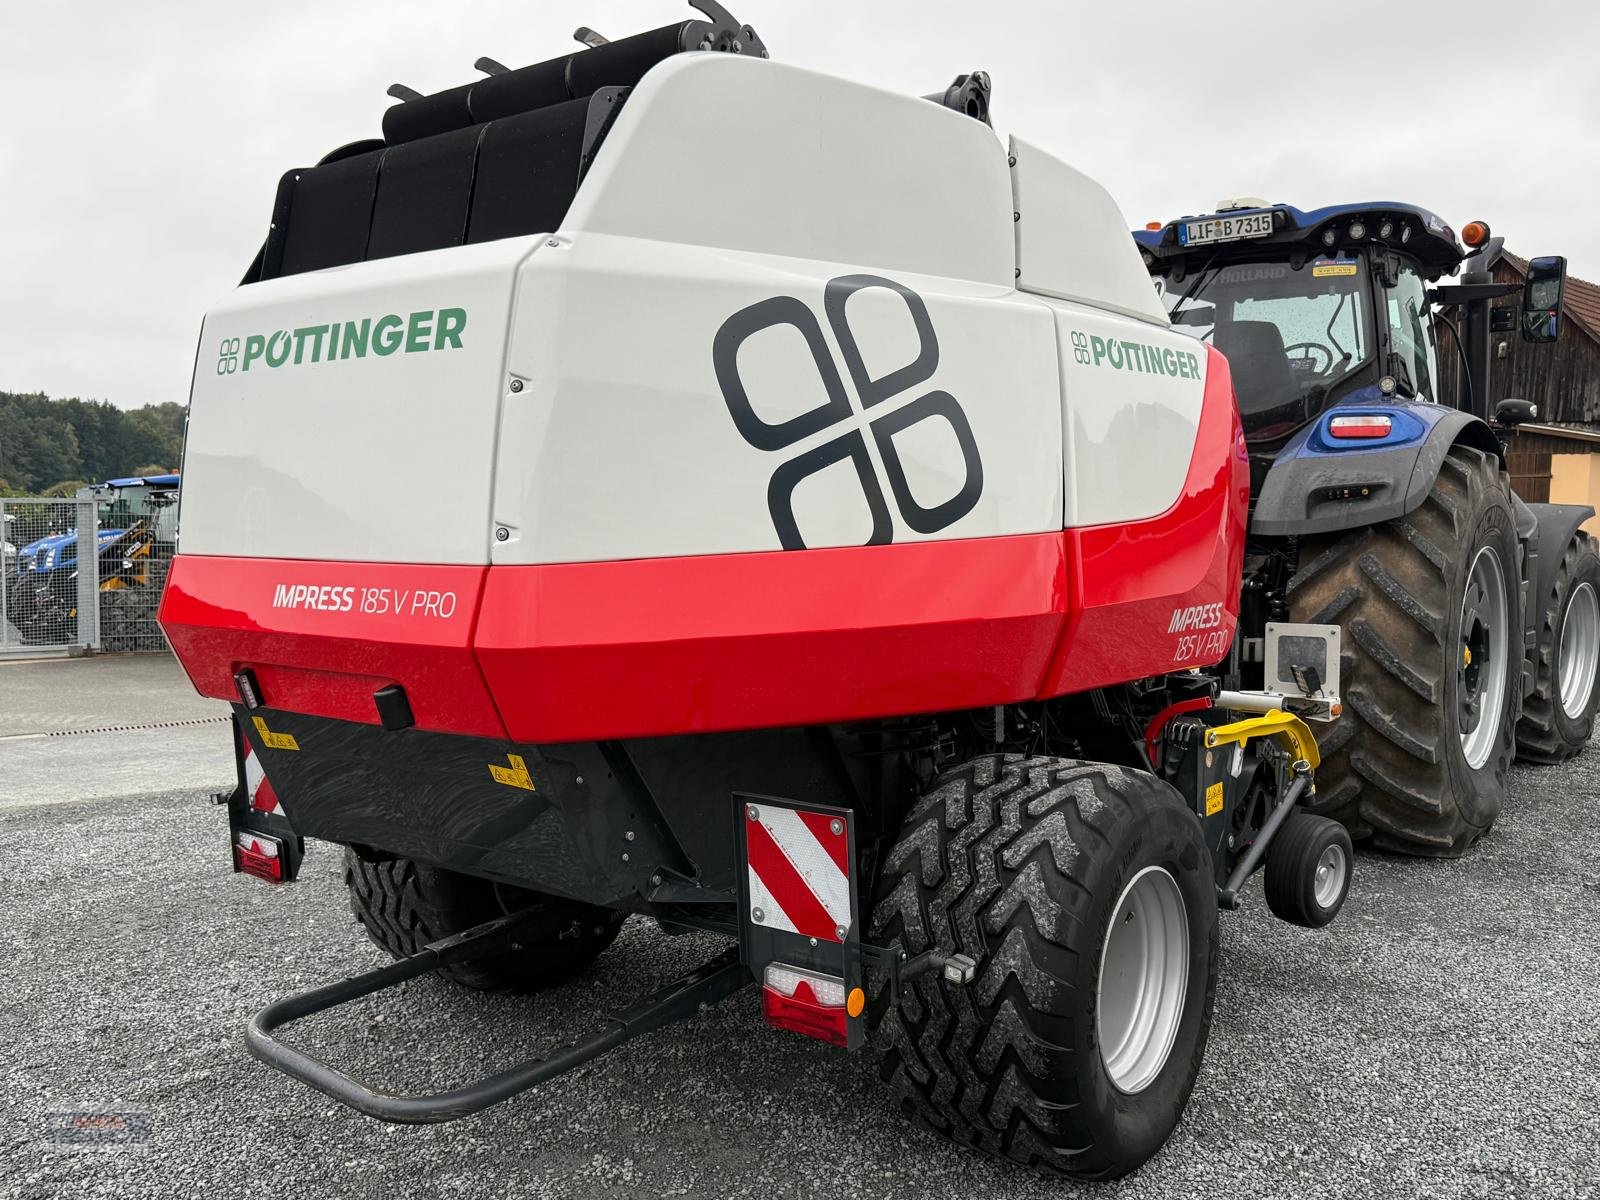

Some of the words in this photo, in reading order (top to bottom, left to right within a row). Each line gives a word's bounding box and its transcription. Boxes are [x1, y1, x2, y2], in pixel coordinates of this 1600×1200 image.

[1187, 222, 1213, 240] LIF
[1223, 220, 1233, 236] B
[1235, 215, 1271, 235] 7315
[1220, 267, 1286, 284] HOLLAND
[242, 307, 467, 372] PÖTTINGER
[1090, 335, 1201, 380] PÖTTINGER
[272, 584, 355, 612] IMPRESS
[359, 588, 391, 614] 185
[394, 590, 409, 615] V
[411, 590, 456, 618] PRO
[1167, 602, 1223, 634] IMPRESS
[1173, 635, 1197, 662] 185
[1195, 633, 1208, 658] V
[1203, 629, 1229, 657] PRO
